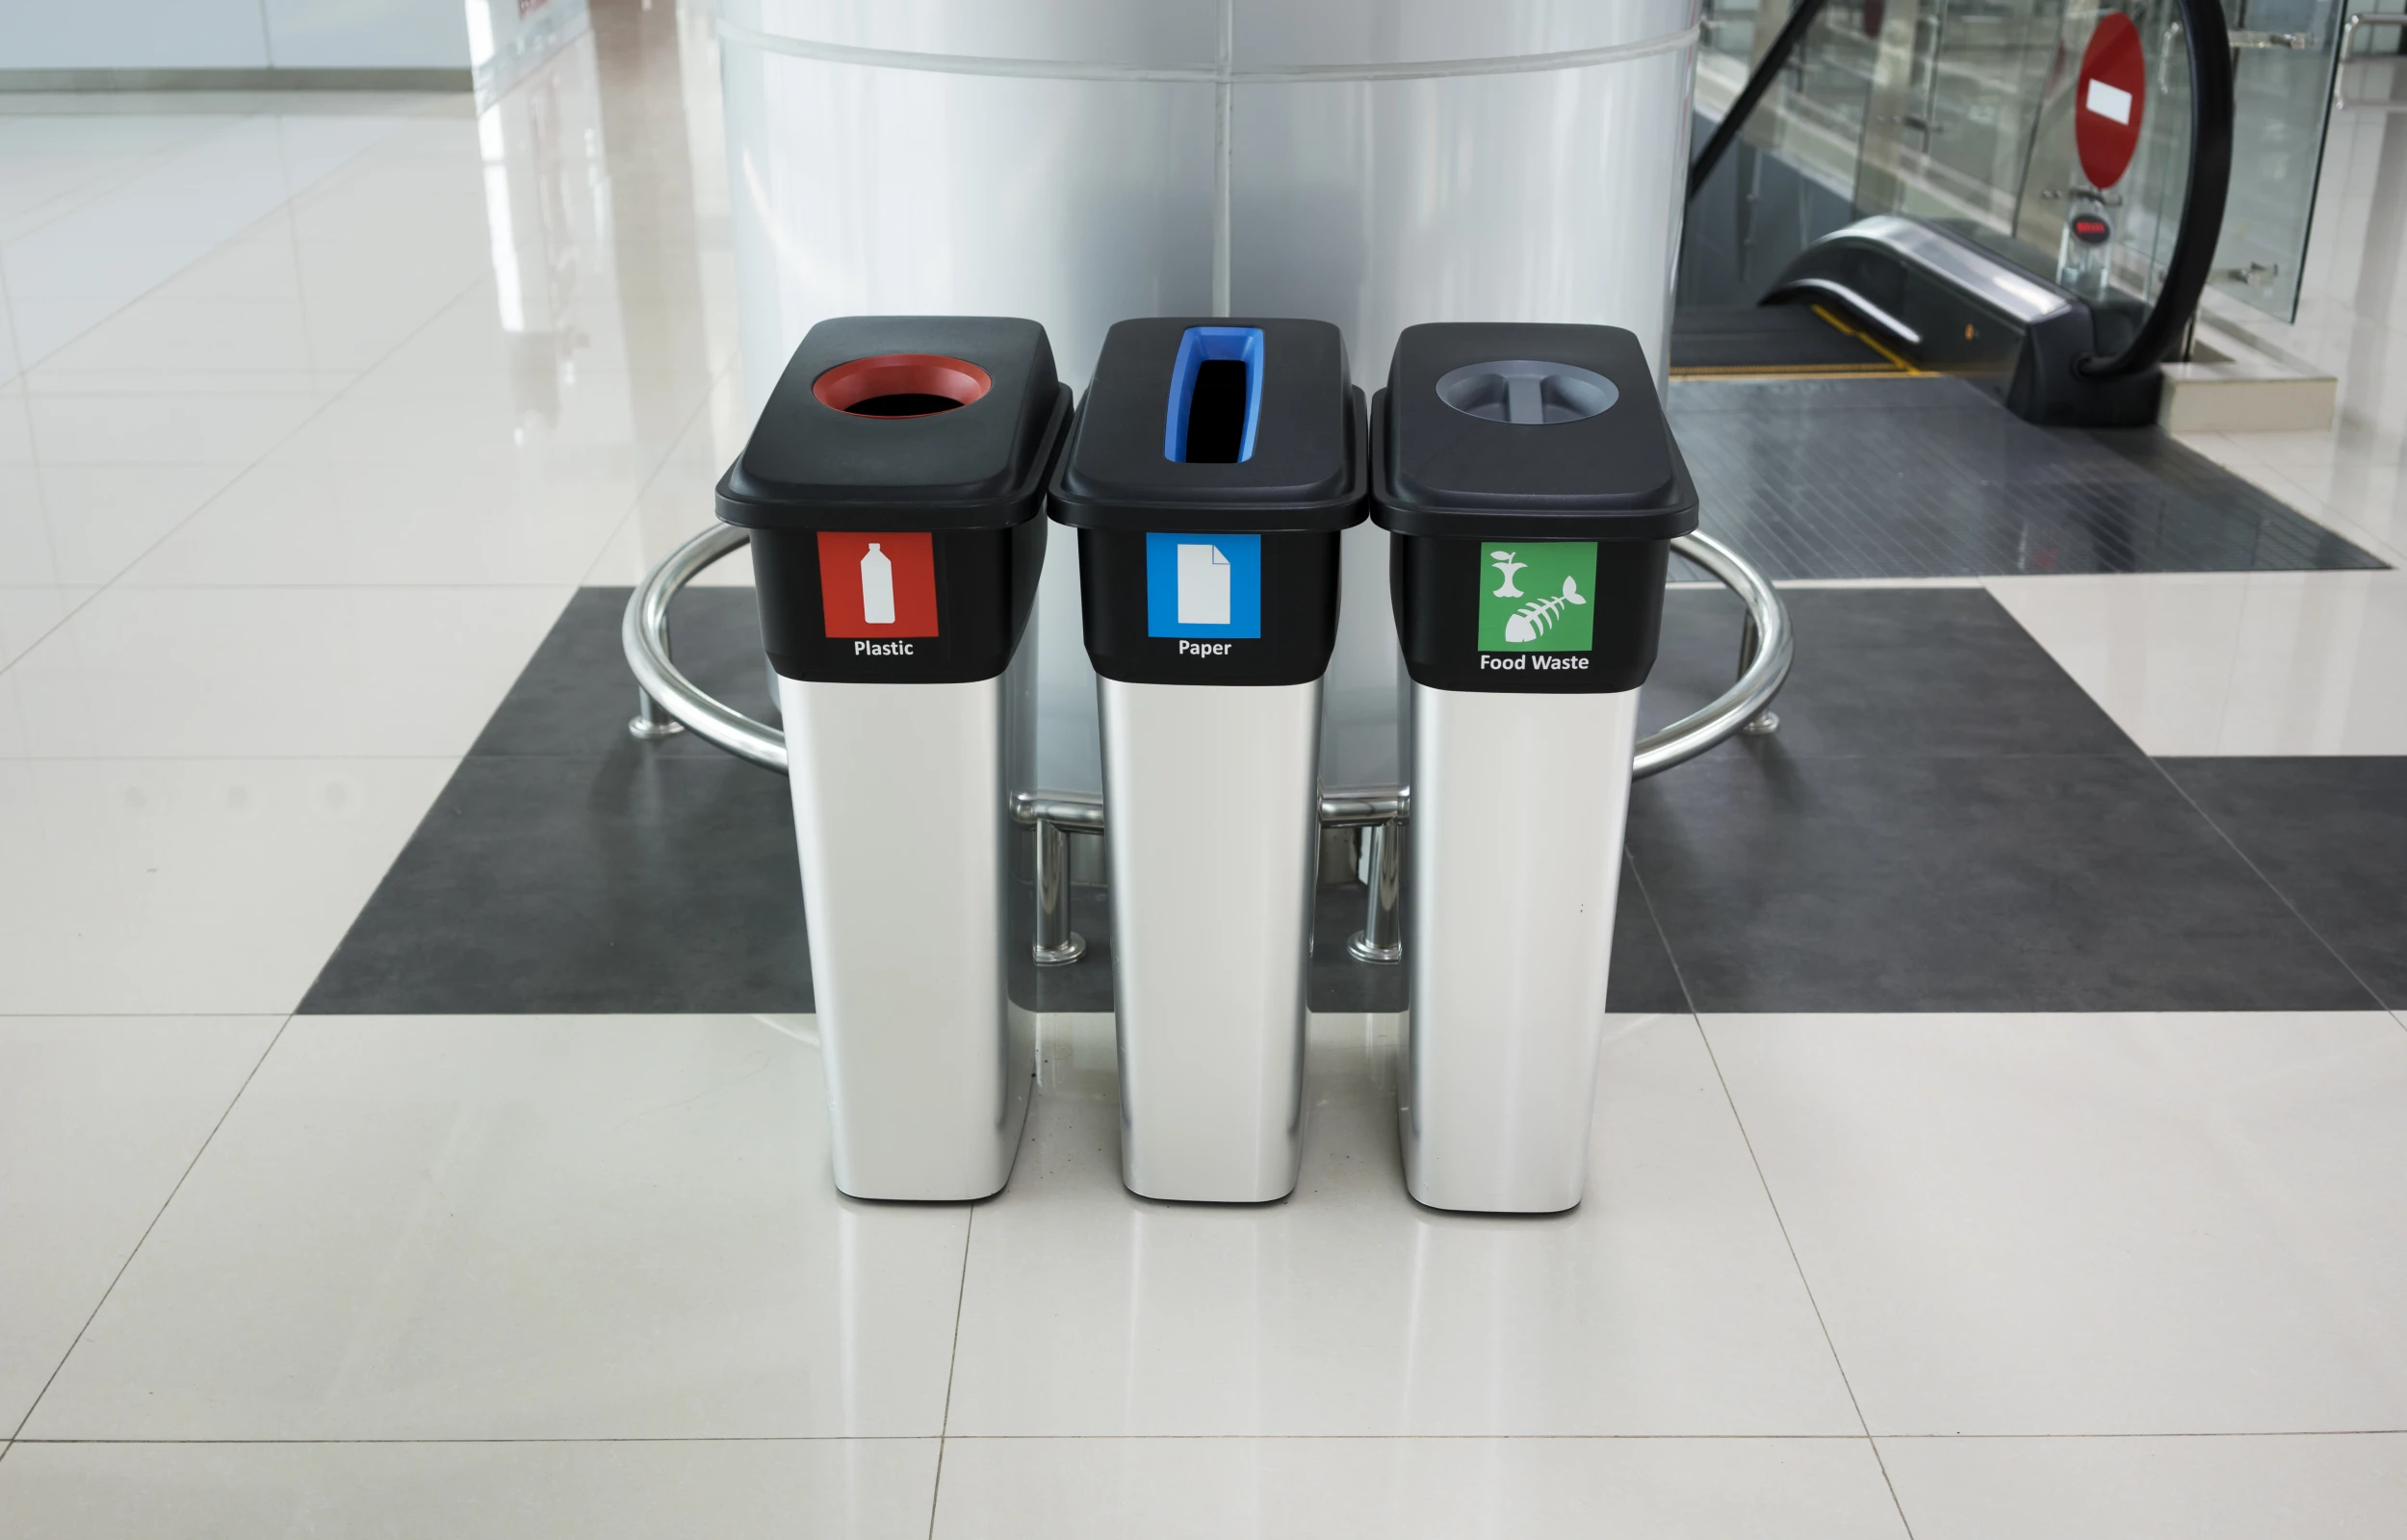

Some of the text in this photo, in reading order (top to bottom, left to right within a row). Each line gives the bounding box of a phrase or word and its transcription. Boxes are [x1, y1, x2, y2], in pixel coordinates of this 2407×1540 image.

[854, 639, 914, 655] Plastic
[1178, 639, 1232, 658] Paper
[1480, 654, 1590, 670] Food Waste
